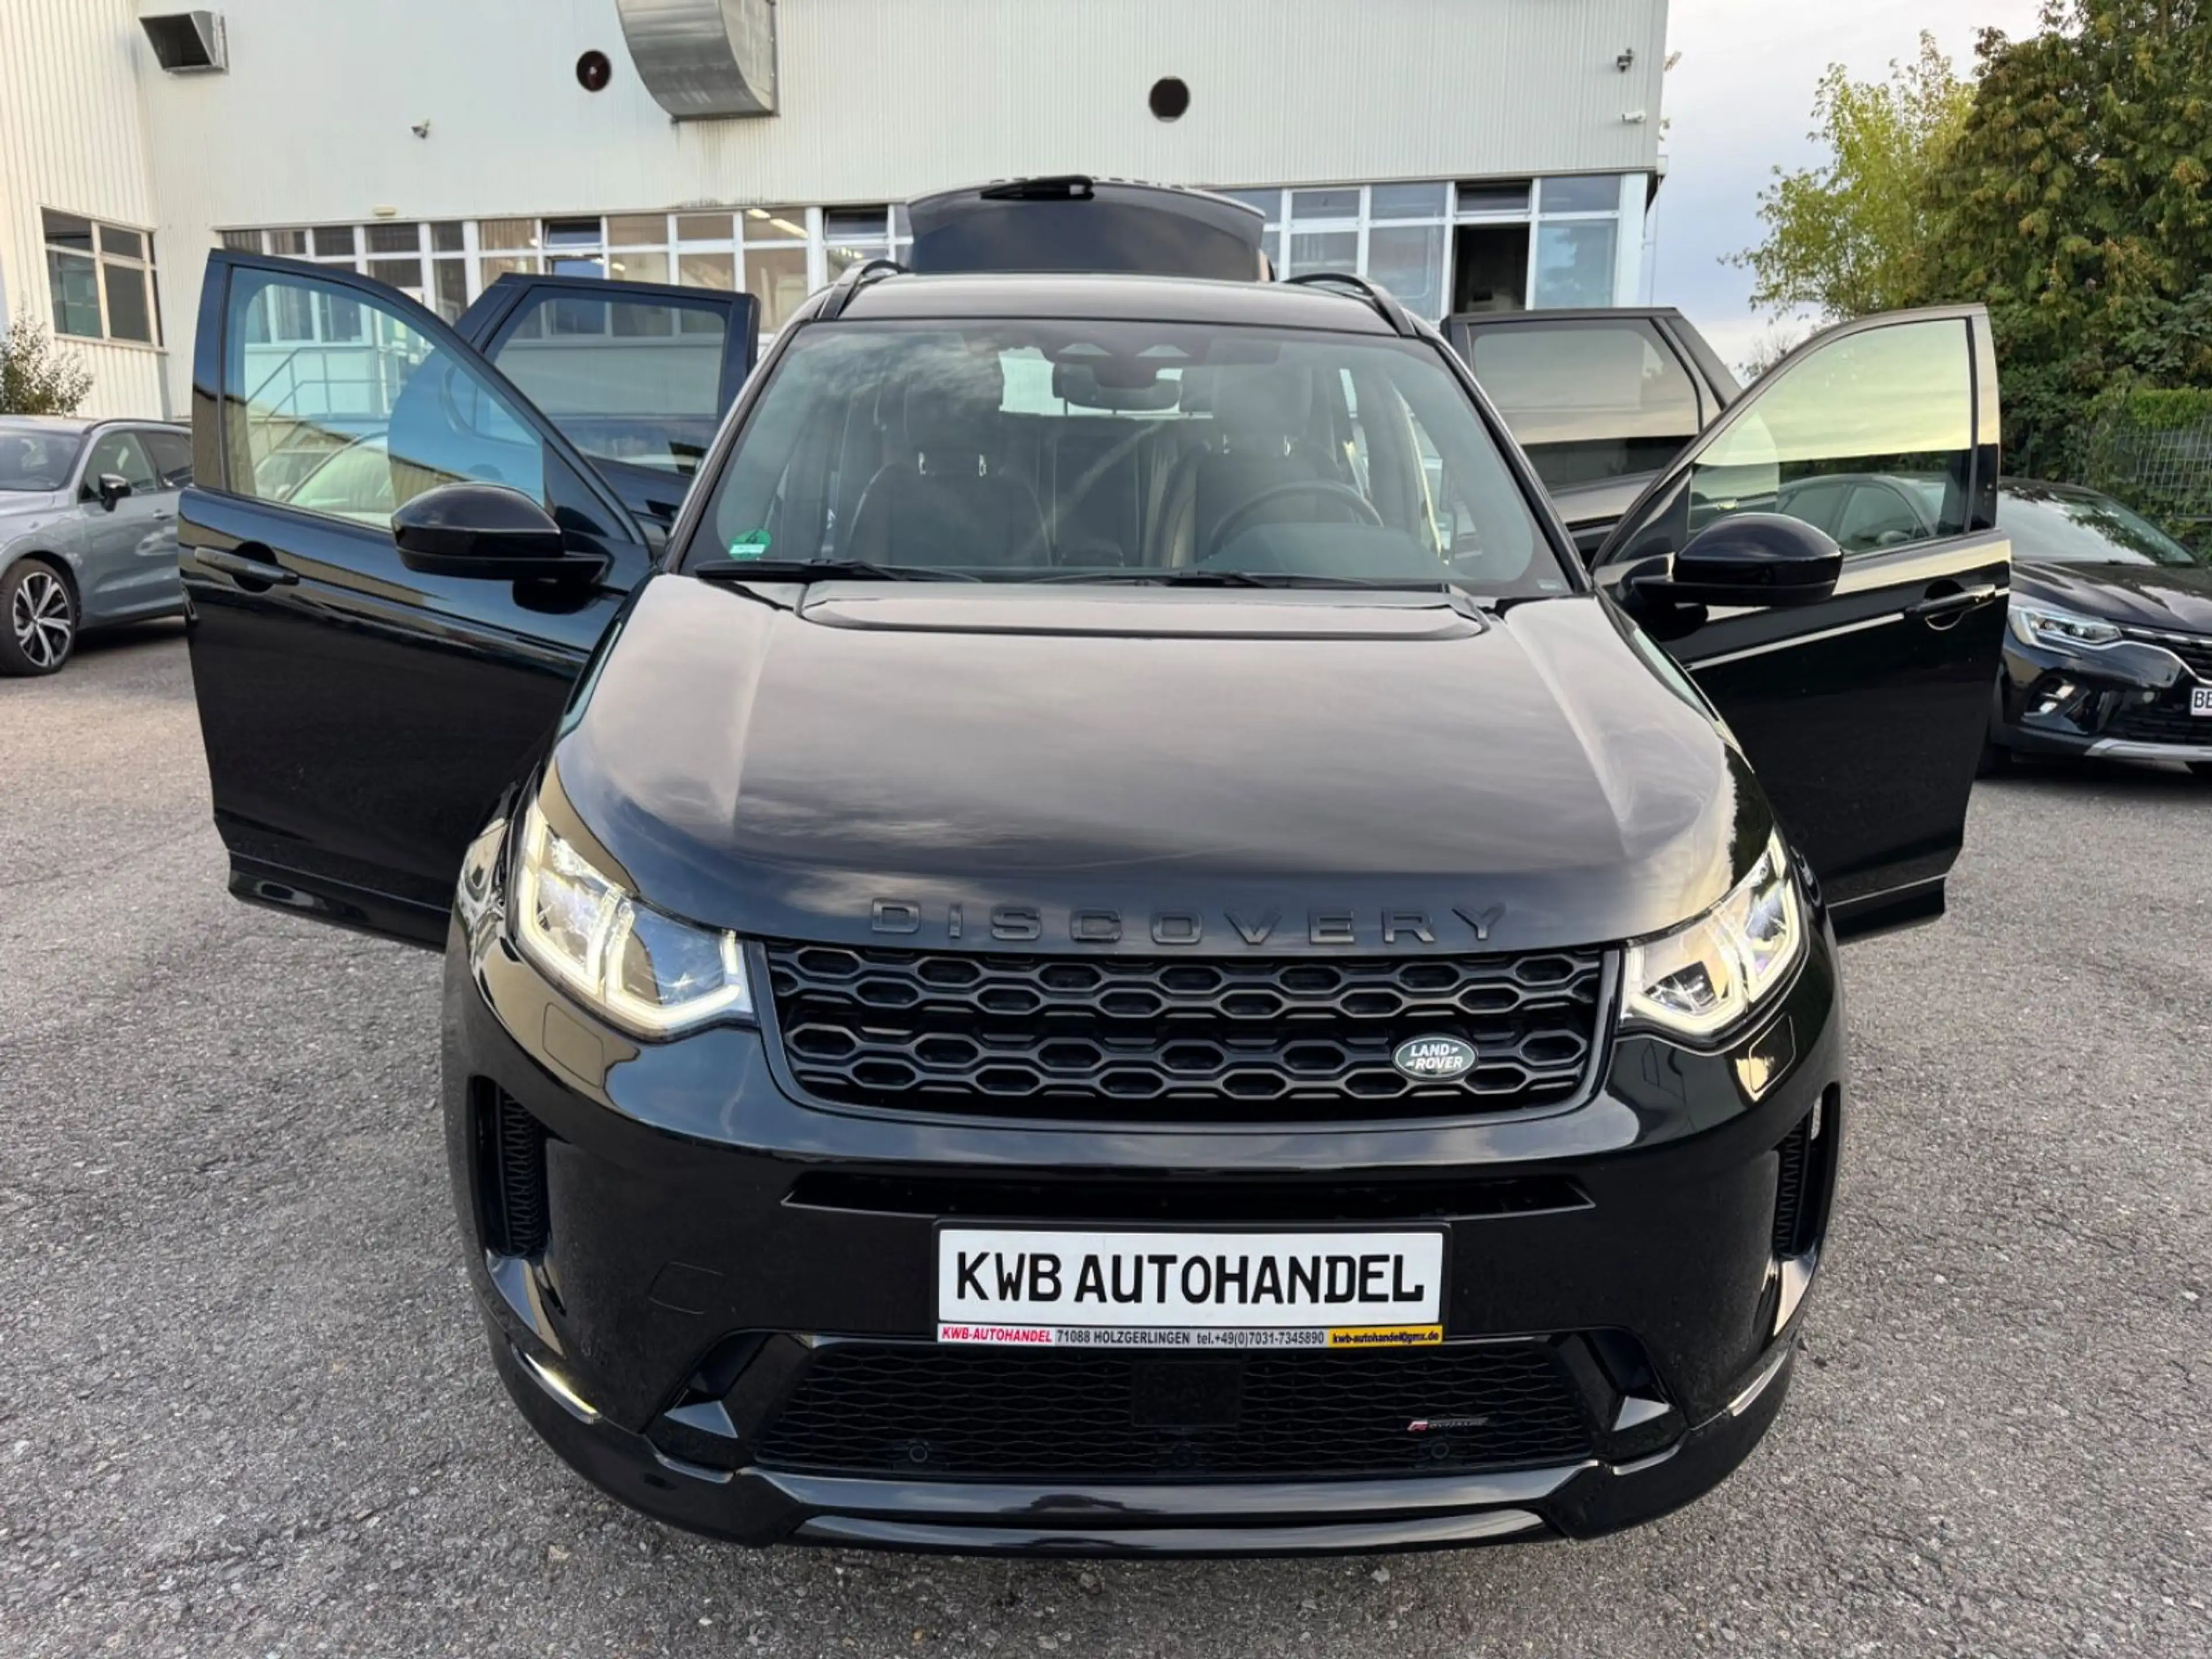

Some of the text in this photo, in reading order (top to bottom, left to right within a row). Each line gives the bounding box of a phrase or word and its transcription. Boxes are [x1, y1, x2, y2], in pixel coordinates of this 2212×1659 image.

[871, 897, 1506, 945] DISCOVERY
[1410, 1043, 1449, 1056] LAND
[1415, 1056, 1463, 1070] ROVER
[957, 1252, 1425, 1304] KWB AUTOHANDEL
[941, 1326, 1052, 1343] KWB-AUTOHANDEL
[1056, 1329, 1092, 1344] 71088
[1093, 1330, 1191, 1346] HOLZGERLINGEN
